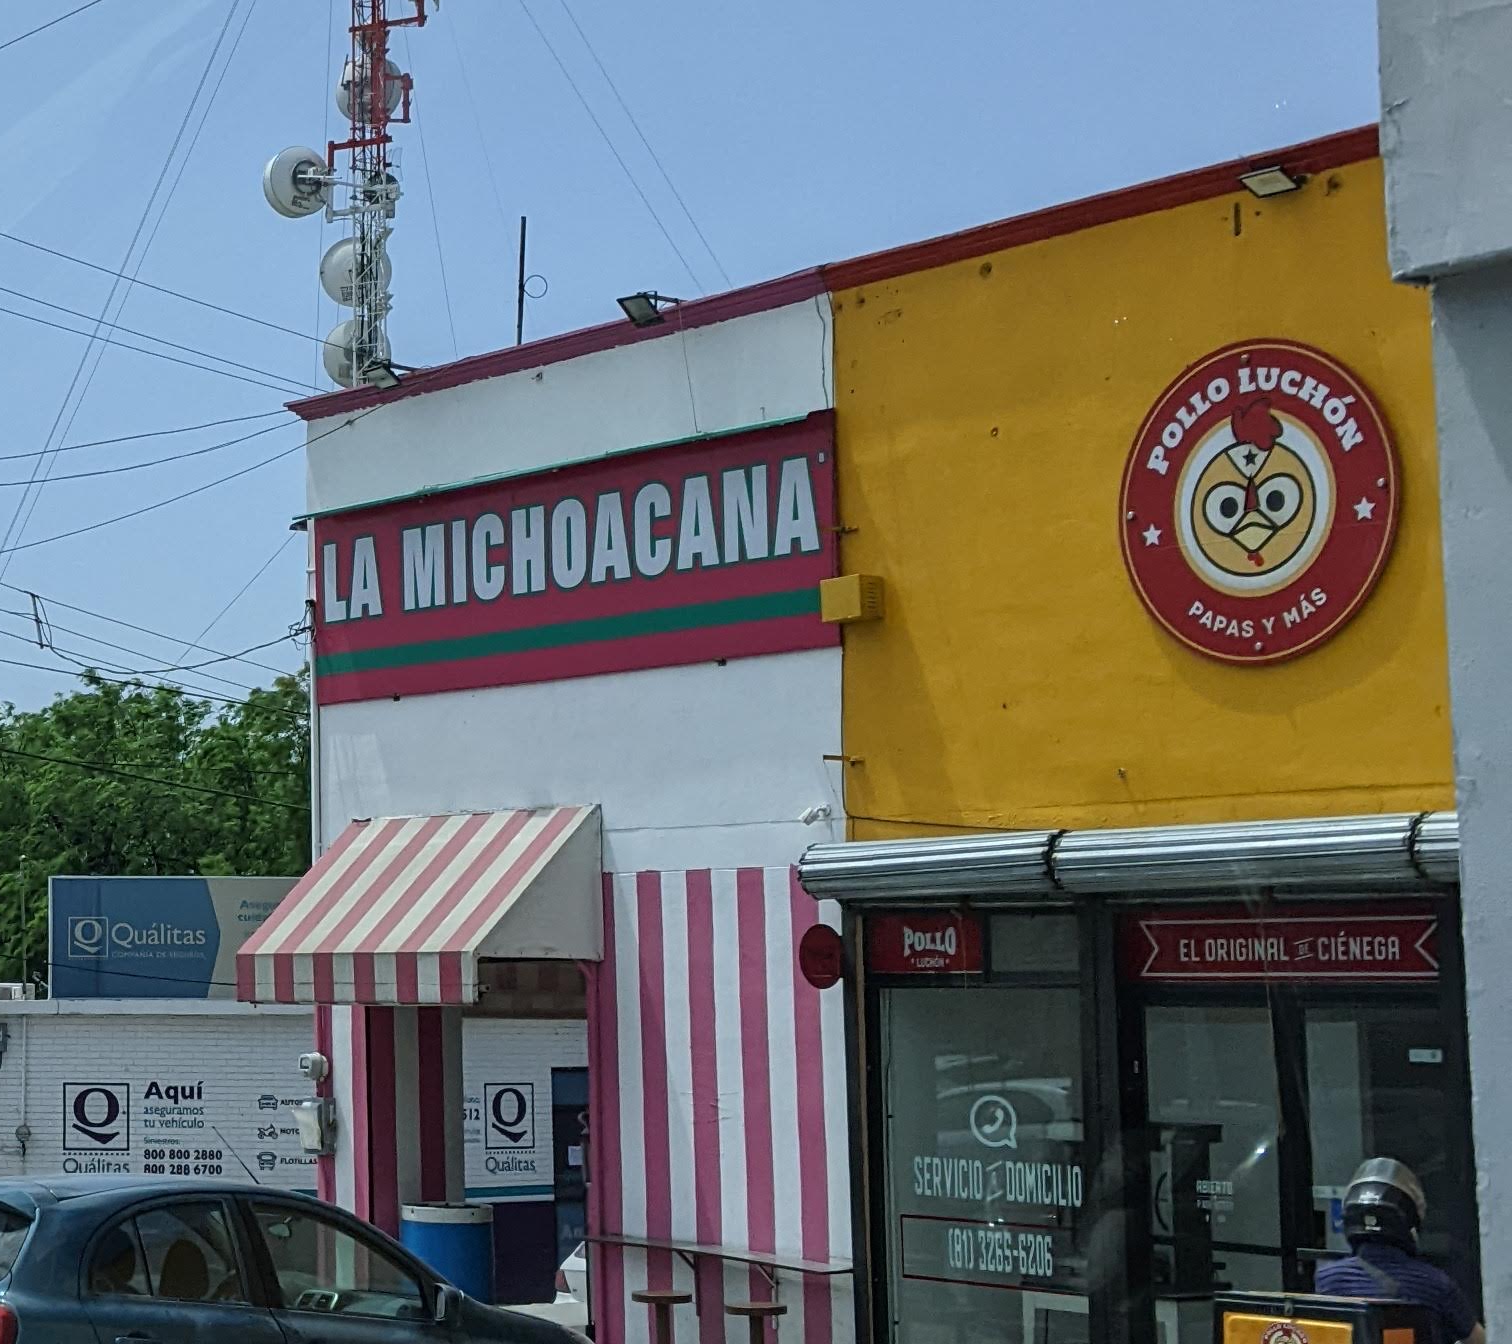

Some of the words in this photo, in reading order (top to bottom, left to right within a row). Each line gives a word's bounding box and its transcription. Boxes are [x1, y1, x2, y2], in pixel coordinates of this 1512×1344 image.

[1147, 376, 1230, 475] POLLO
[1238, 367, 1363, 452] LUCHÓN
[323, 535, 383, 623] LA
[402, 456, 820, 611] MICHOACANA
[1188, 601, 1254, 638] PAPAS
[1262, 616, 1275, 635] Y
[1283, 586, 1328, 629] MÁS
[111, 921, 206, 948] Quálitas
[903, 926, 956, 957] POLLO
[1179, 939, 1200, 962] EL
[1205, 937, 1289, 961] ORIGINAL
[1318, 931, 1400, 961] CIÉNEGA
[143, 1081, 205, 1105] Aquí
[143, 1106, 205, 1117] aseguramos
[143, 1119, 158, 1129] tu
[160, 1117, 205, 1129] vehículo
[143, 1149, 166, 1161] 800
[168, 1149, 191, 1161] 800
[193, 1149, 223, 1161] 2880
[143, 1164, 166, 1175] 800
[169, 1164, 191, 1175] 288
[193, 1164, 223, 1175] 6700
[485, 1156, 536, 1175] Quálitas
[913, 1156, 983, 1201] SERVICIO
[1006, 1160, 1083, 1208] DOMICILIO
[947, 1227, 974, 1270] (81)
[977, 1229, 1054, 1277] 3265-6206
